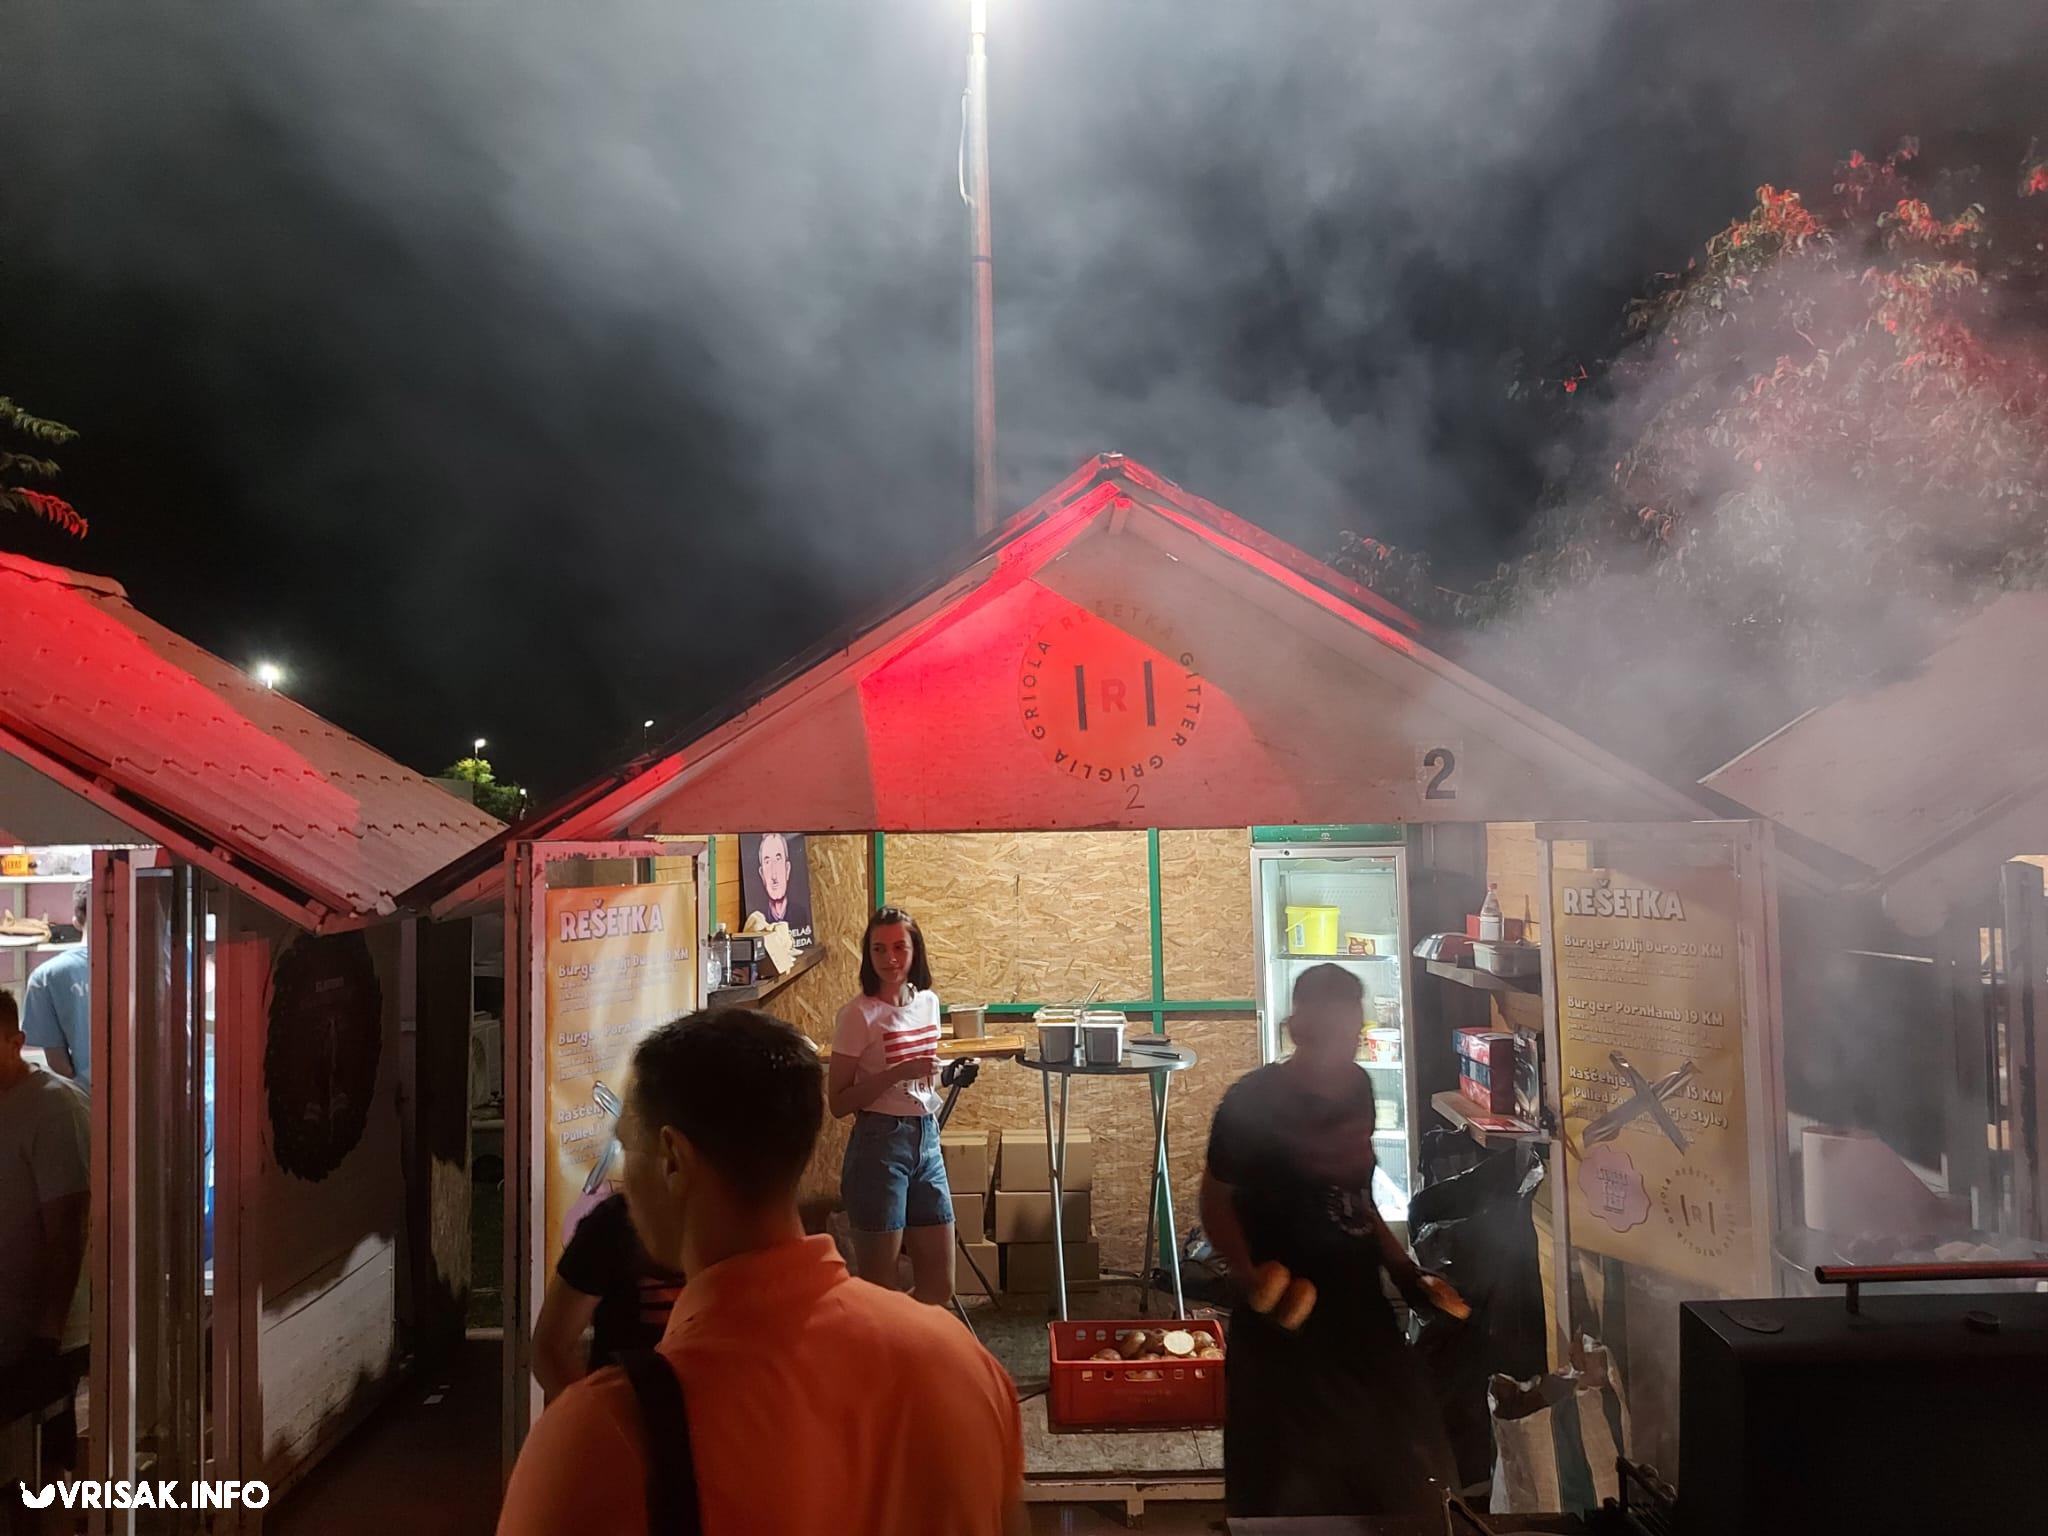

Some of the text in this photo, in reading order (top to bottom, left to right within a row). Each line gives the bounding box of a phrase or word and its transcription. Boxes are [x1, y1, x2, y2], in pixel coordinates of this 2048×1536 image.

[1171, 652, 1201, 747] GITTER
[1054, 748, 1164, 782] GRIGLIA
[1423, 747, 1457, 800] 2
[1126, 784, 1145, 810] 2
[1563, 879, 1686, 922] REŠETKA
[560, 898, 664, 943] REŠETKA
[1564, 934, 1609, 954] Burger
[1681, 943, 1697, 956] 20
[1701, 944, 1723, 959] KM
[1567, 996, 1612, 1017] Burger
[1615, 1001, 1681, 1021] PornHamb
[1684, 1009, 1699, 1024] 19
[1701, 1012, 1725, 1026] KM
[1702, 1090, 1723, 1105] KM
